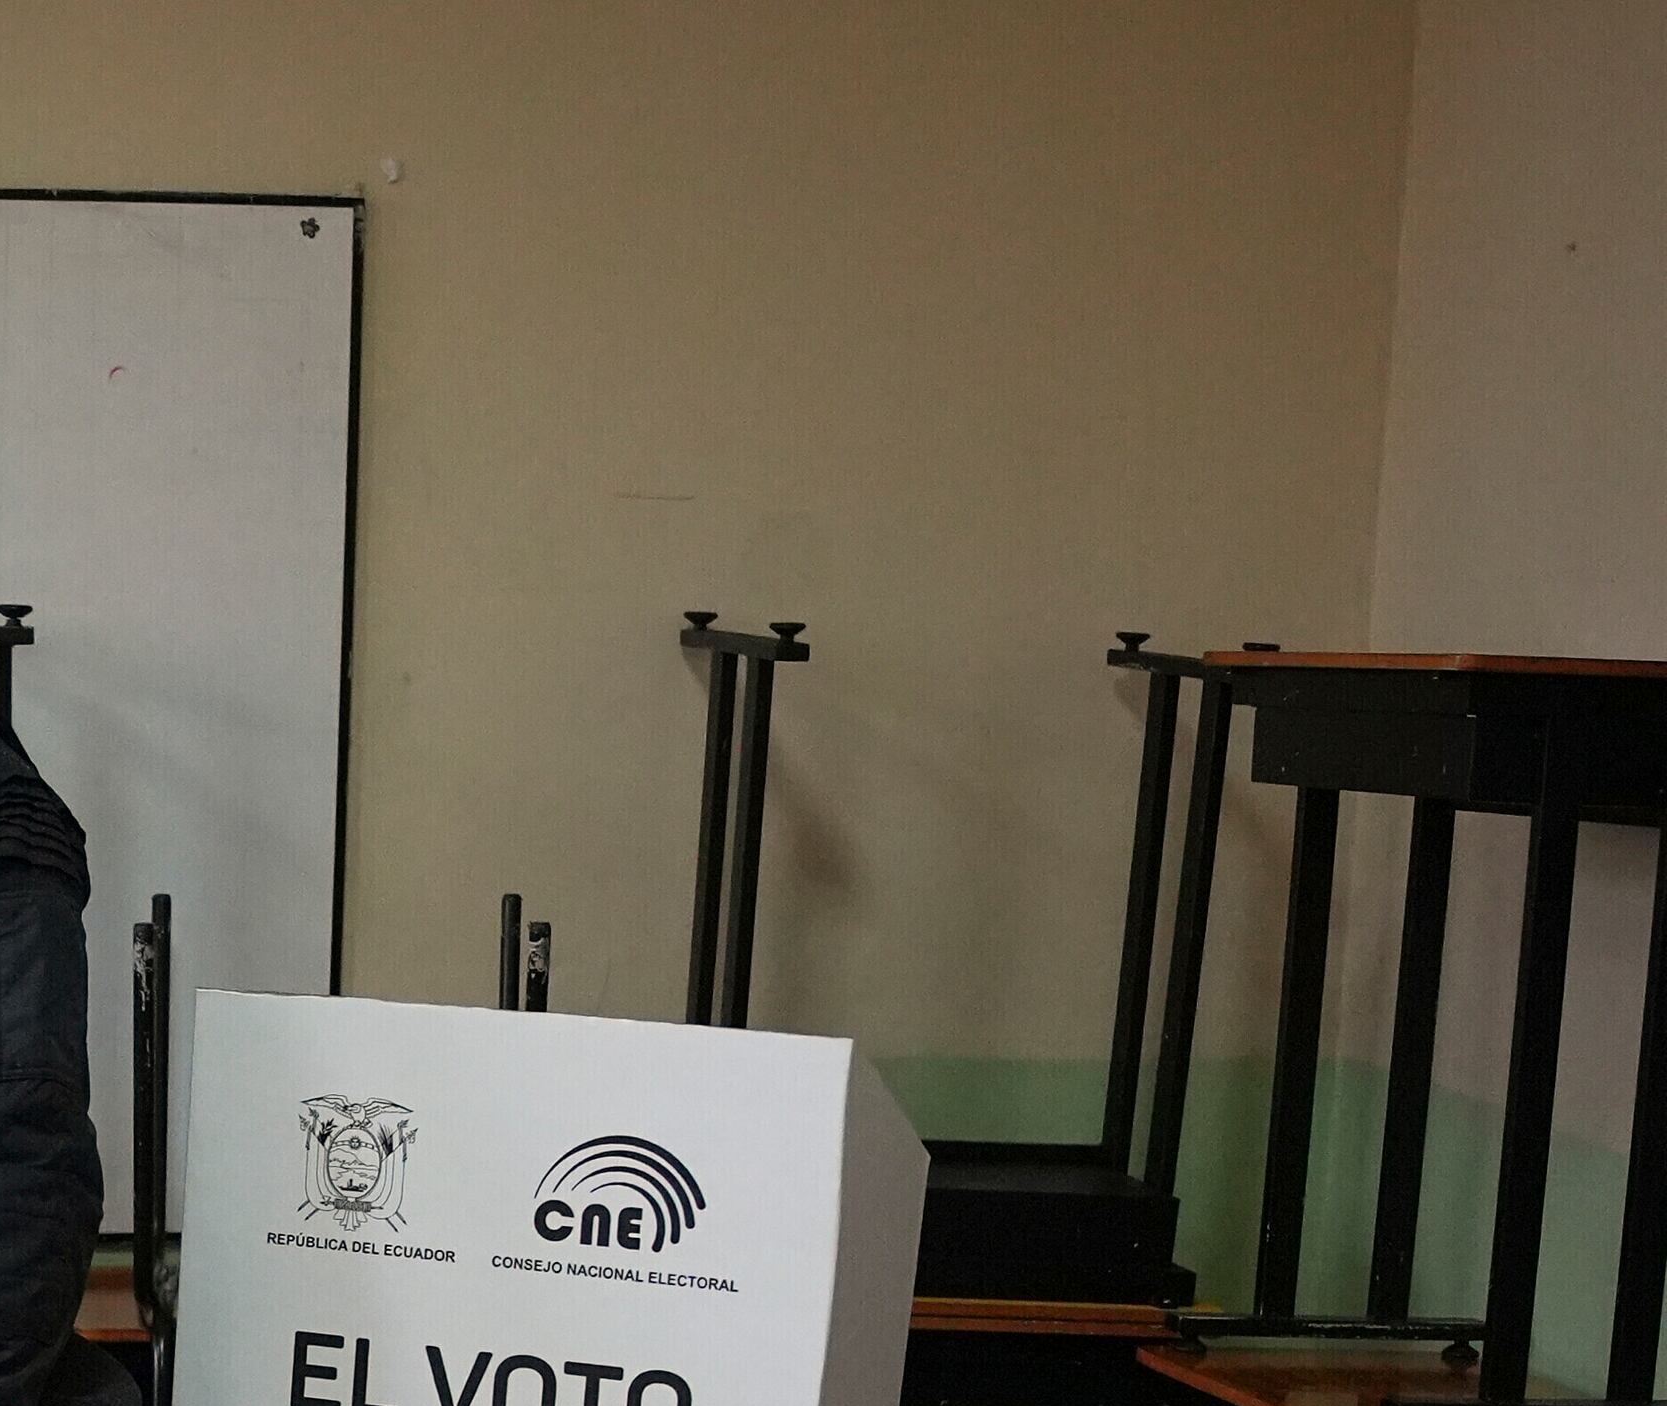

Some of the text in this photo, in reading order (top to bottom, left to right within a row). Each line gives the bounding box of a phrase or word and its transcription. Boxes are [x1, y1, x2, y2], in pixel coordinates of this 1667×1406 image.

[534, 1200, 643, 1250] CNE
[266, 1232, 456, 1263] REPÚBLICA DEL ECUADOR
[491, 1255, 739, 1293] CONSEJO NACIONAL ELECTORAL
